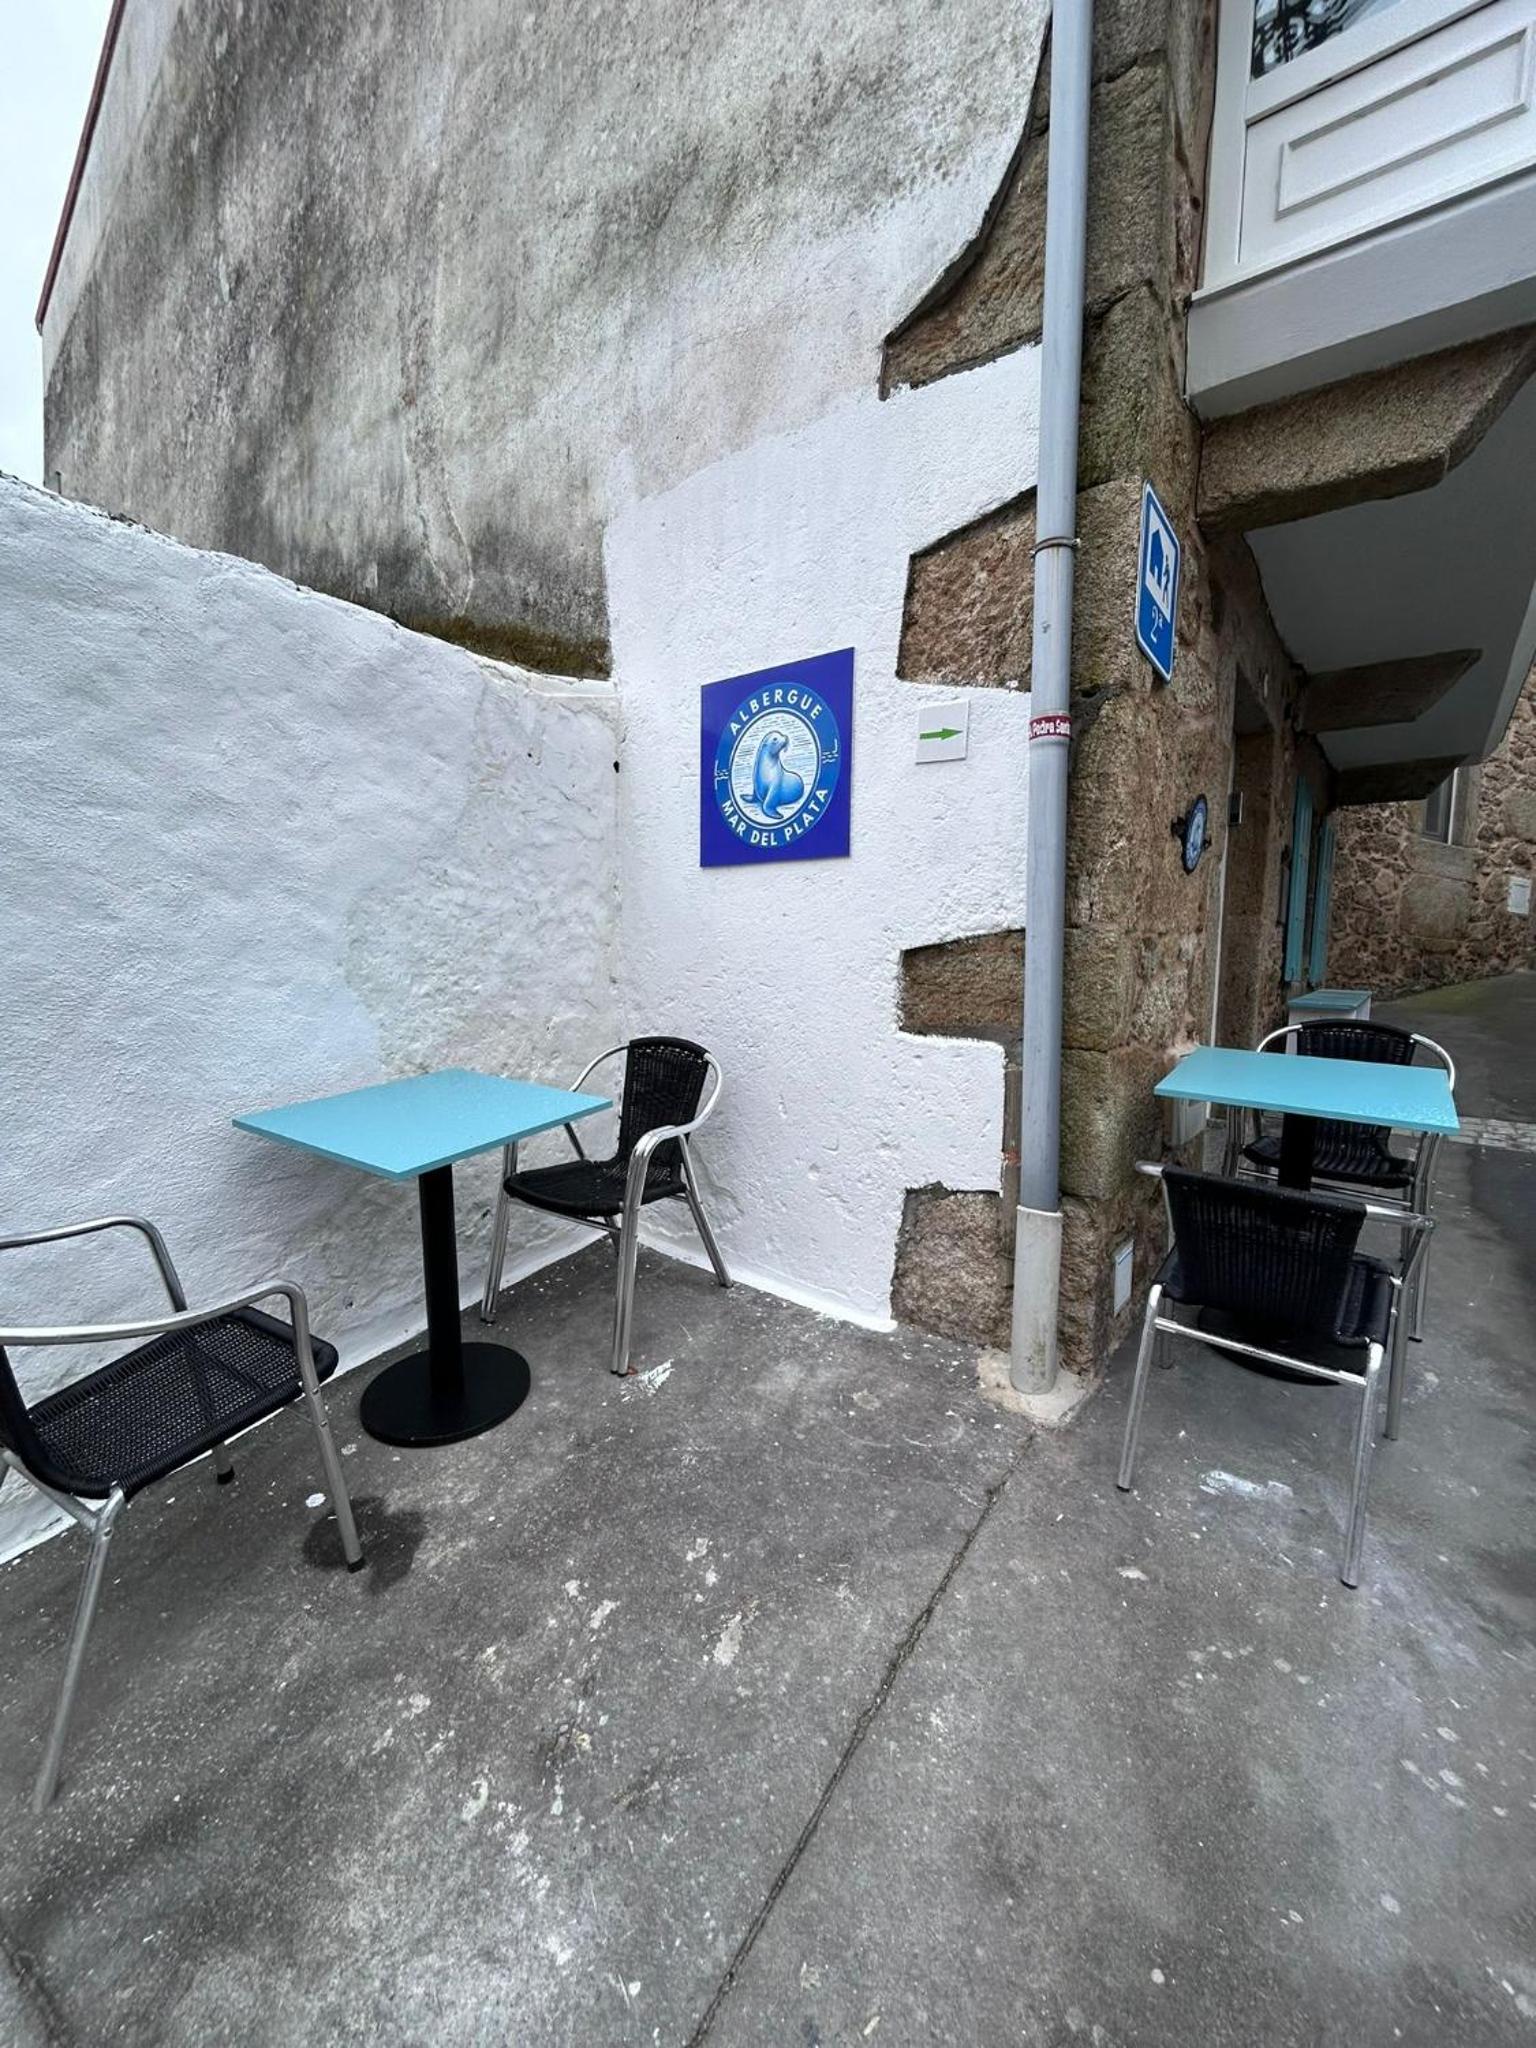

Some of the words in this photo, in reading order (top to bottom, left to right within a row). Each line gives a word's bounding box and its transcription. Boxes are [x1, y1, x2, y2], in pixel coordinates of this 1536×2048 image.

[729, 688, 823, 737] ALBERGUE
[721, 799, 746, 837] MAR
[750, 832, 778, 847] DEL
[785, 788, 829, 842] PLATA
